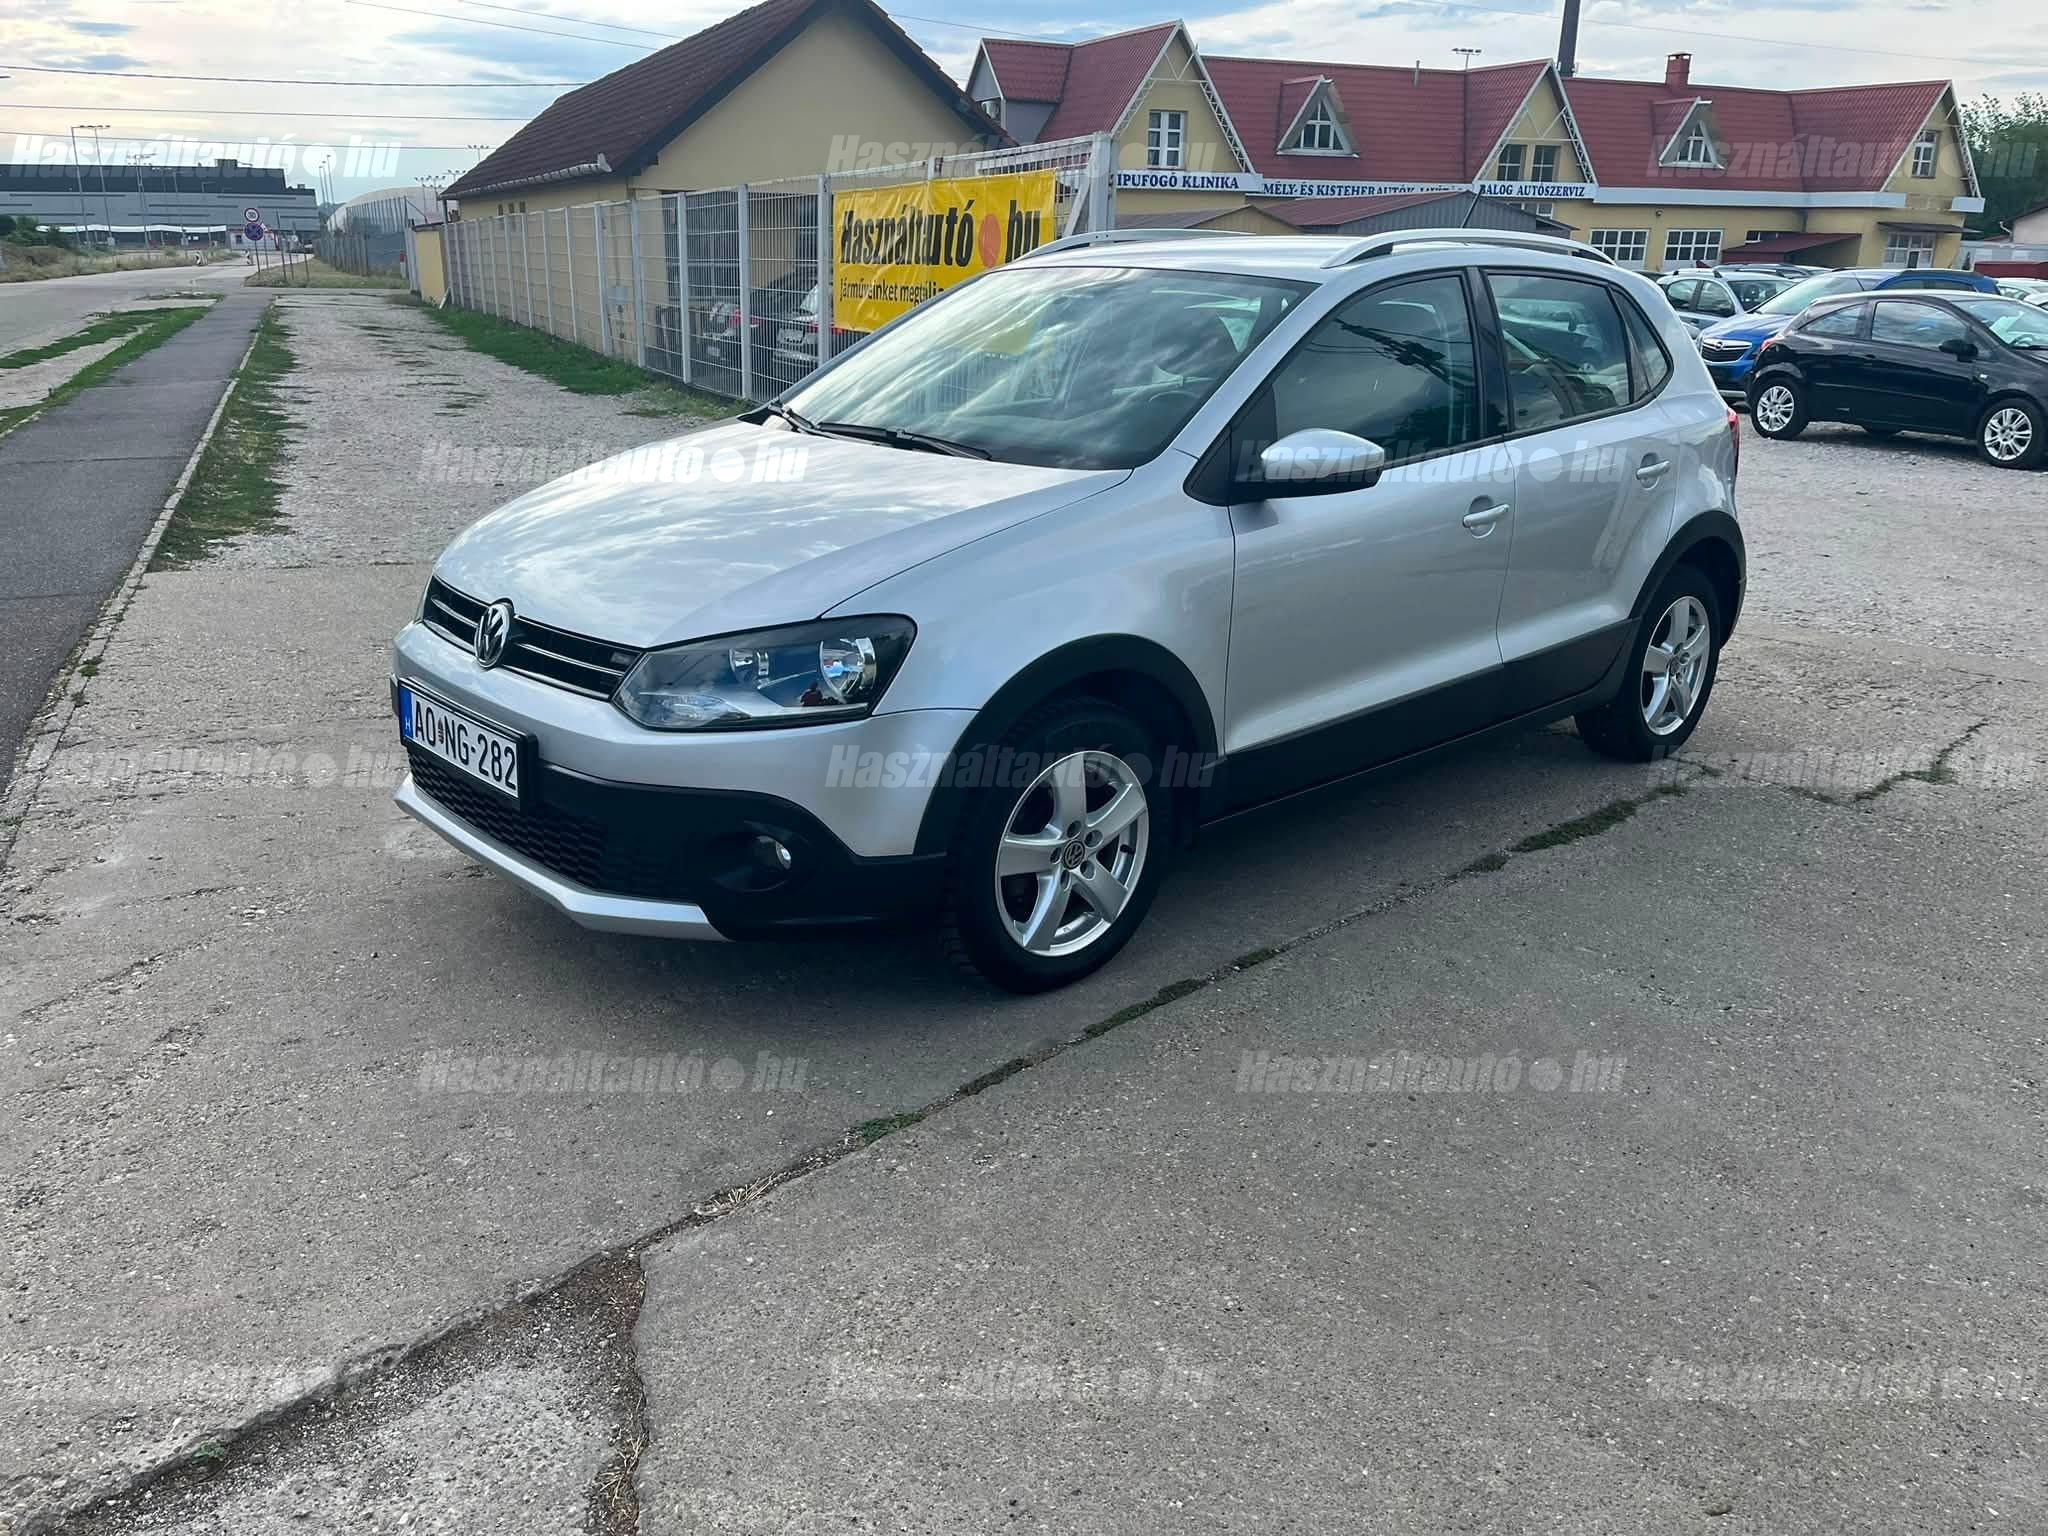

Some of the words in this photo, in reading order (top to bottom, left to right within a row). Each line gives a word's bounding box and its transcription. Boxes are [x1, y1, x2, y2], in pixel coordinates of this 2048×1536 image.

[1109, 171, 1178, 187] IPUFOGÓ
[1182, 175, 1239, 190] KLINIKA
[1480, 184, 1513, 196] BALOG
